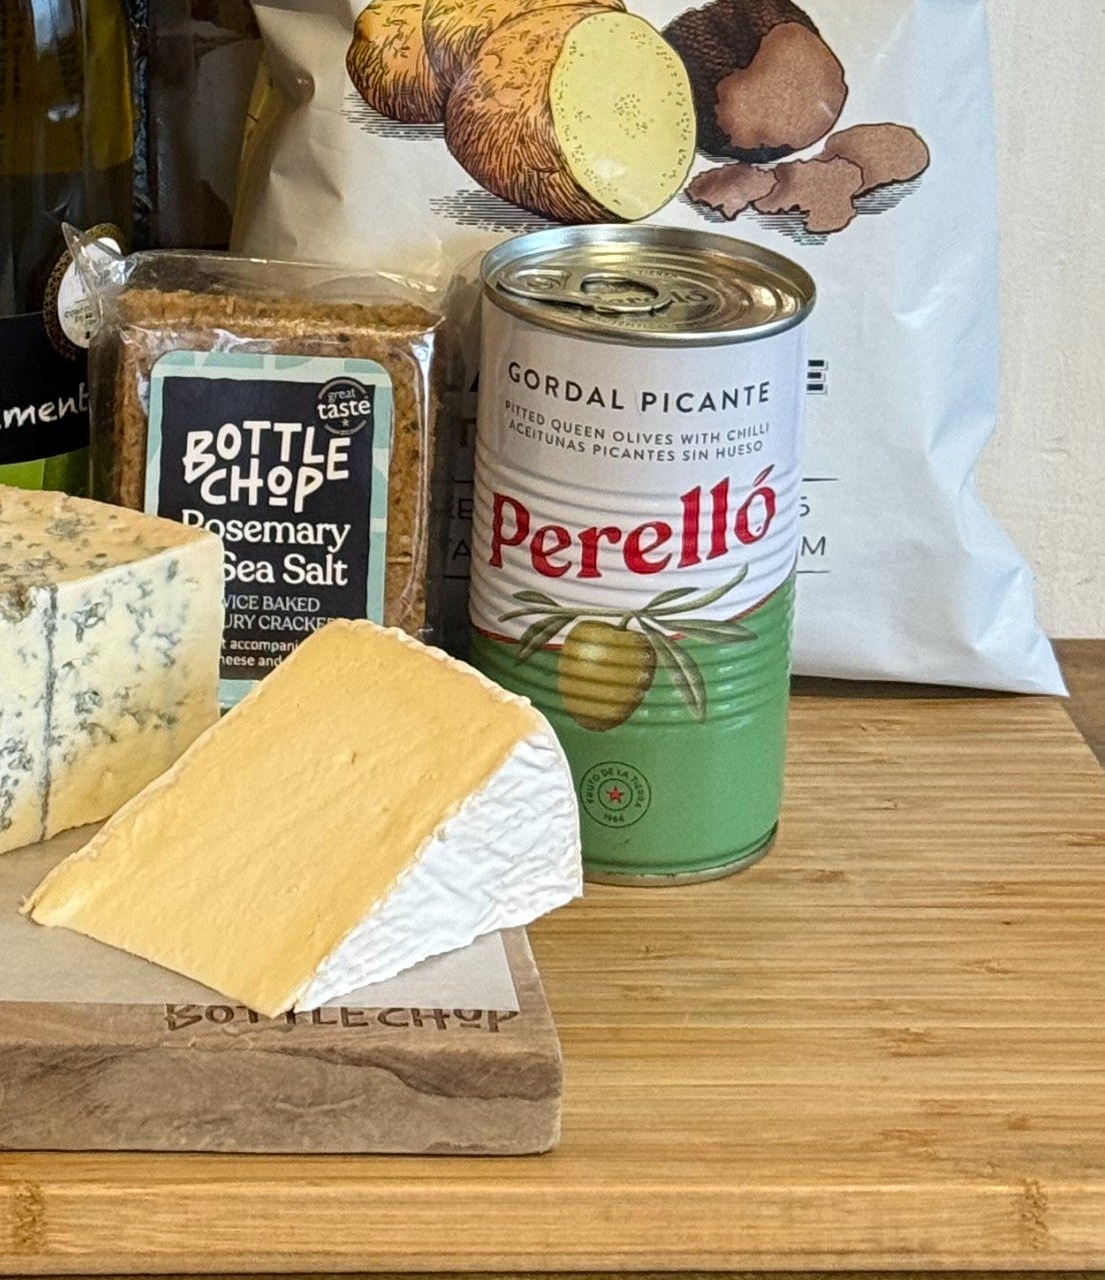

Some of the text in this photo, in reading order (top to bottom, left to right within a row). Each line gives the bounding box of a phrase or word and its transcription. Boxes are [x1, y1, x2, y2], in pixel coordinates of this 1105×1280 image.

[317, 400, 372, 420] taste
[327, 388, 356, 403] great
[508, 361, 625, 411] GORDAL
[641, 381, 771, 414] PICANTE
[505, 399, 771, 446] PITTED QUEEN OLIVES WITH CHILLI
[508, 419, 764, 462] ACEITUNAS PICANTES SIN HUESO
[182, 420, 352, 485] BOTTLE
[200, 457, 324, 514] CHOP
[488, 463, 777, 579] Perelló
[222, 550, 349, 586] Sea Salt
[262, 595, 321, 613] BAKED
